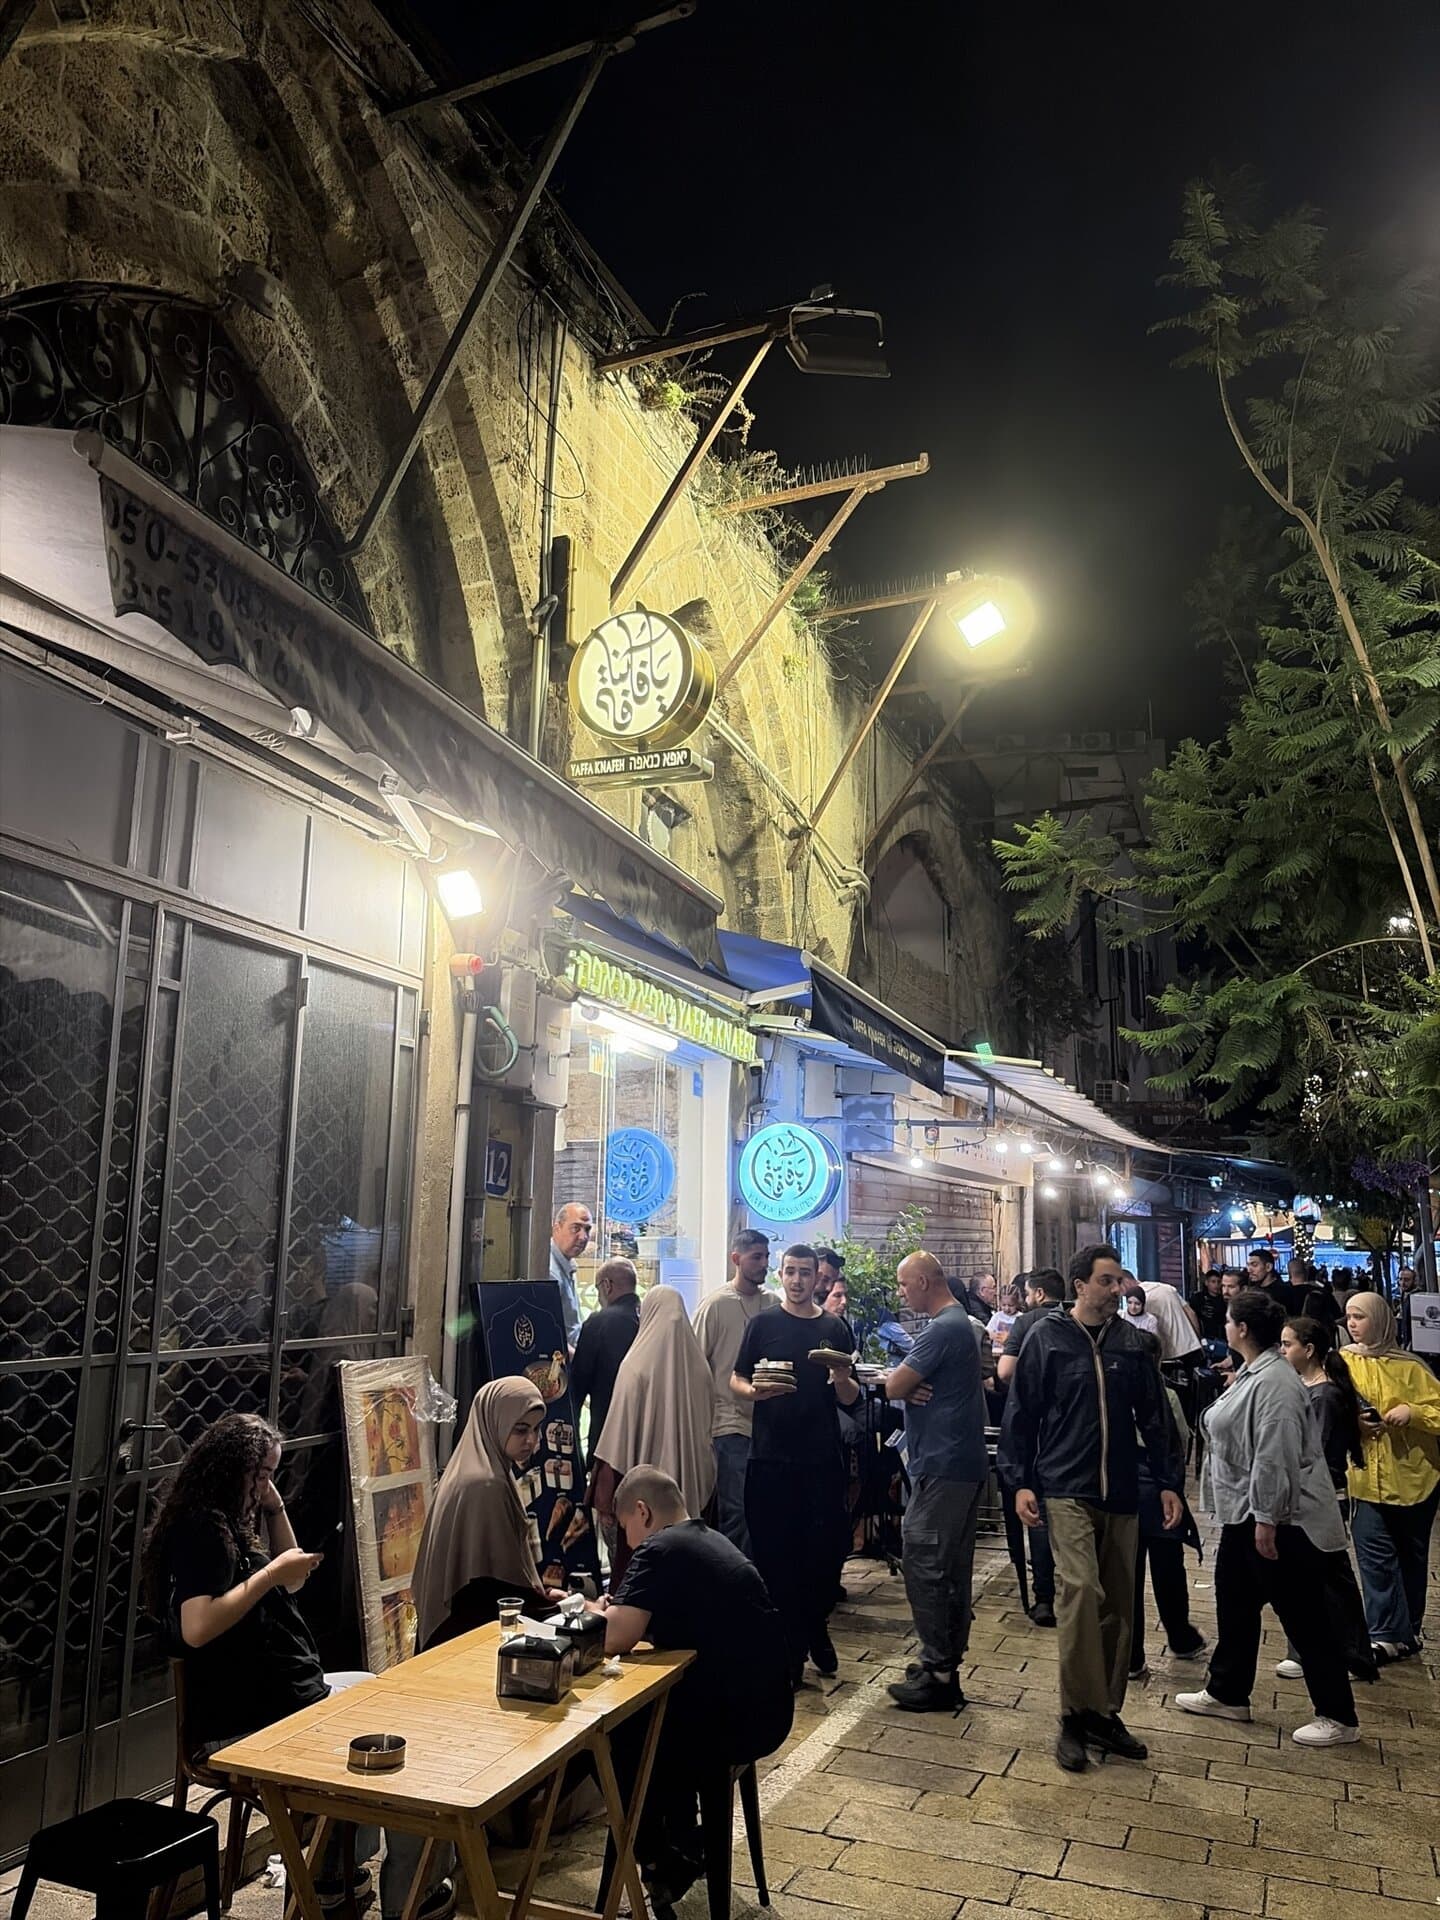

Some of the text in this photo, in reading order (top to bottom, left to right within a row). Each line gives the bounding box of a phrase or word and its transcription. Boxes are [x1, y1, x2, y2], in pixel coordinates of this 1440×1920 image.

[571, 758, 625, 777] YAFFA KNAFEH
[629, 750, 688, 771] יאפא כנאפה
[677, 998, 713, 1045] YAFFA
[487, 1150, 508, 1187] 12
